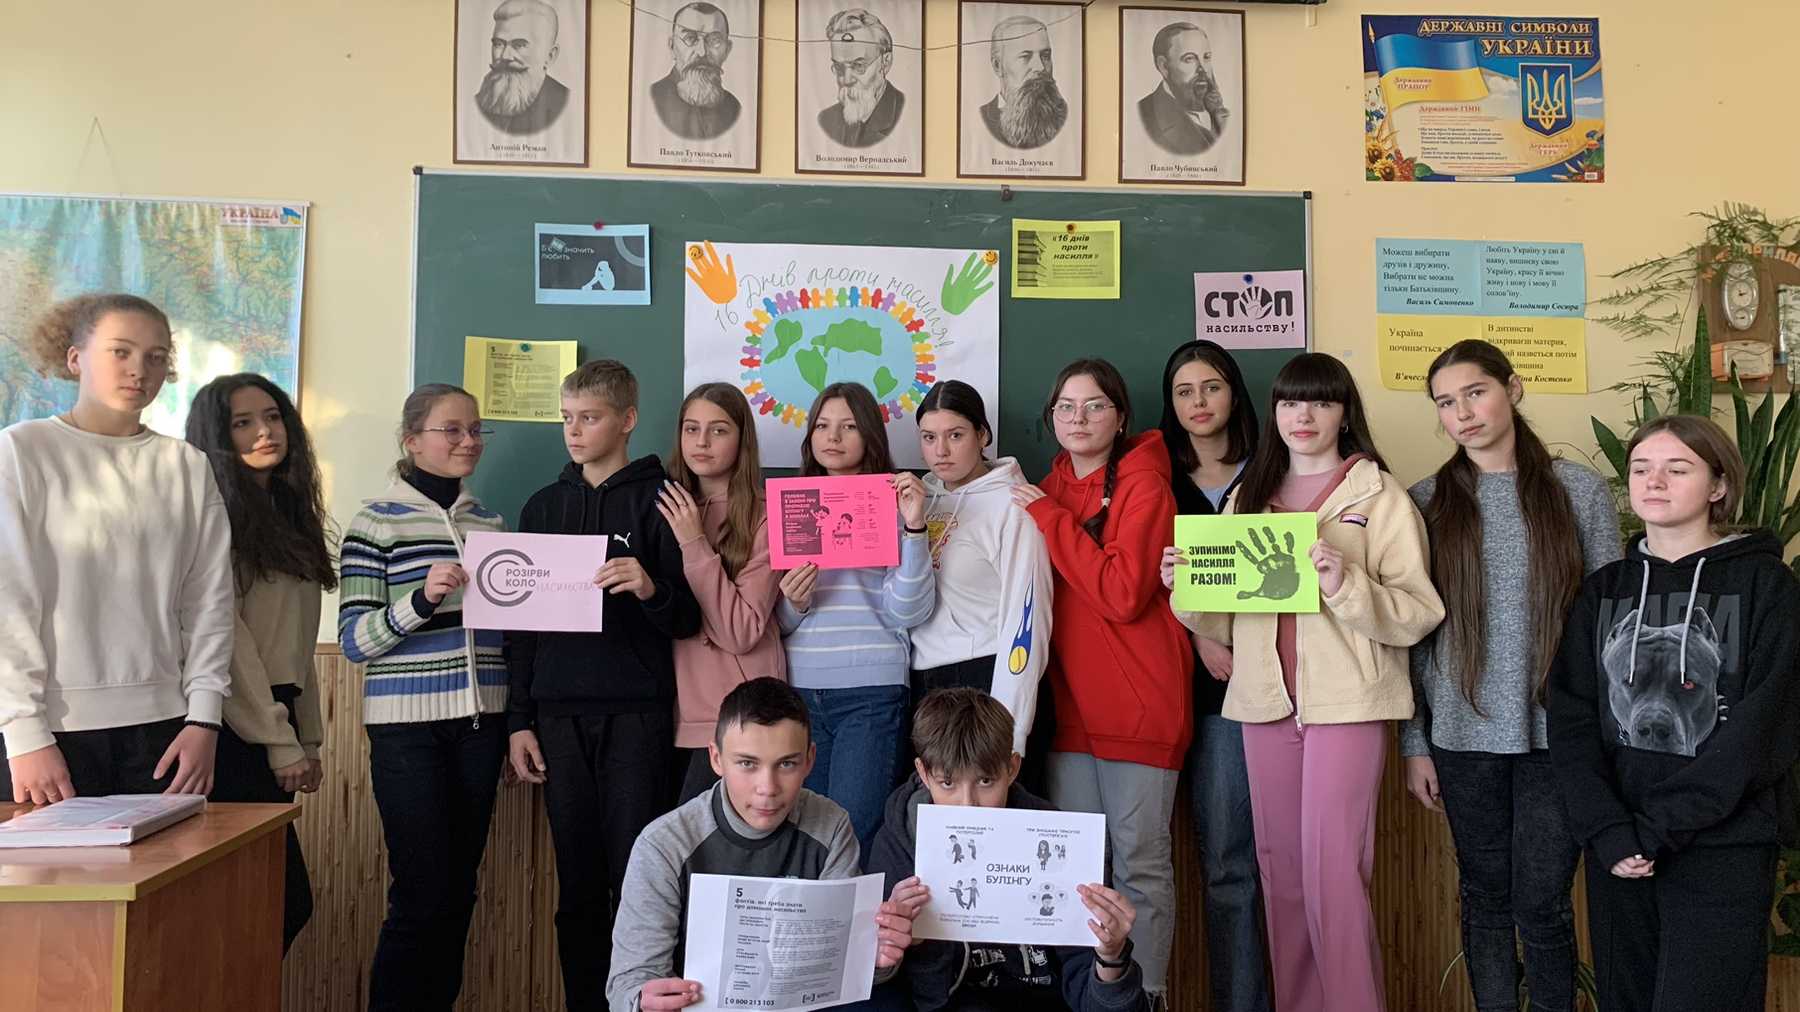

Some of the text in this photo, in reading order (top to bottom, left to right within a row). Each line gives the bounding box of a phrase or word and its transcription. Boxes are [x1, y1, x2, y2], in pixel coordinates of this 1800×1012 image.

[1418, 19, 1592, 36] ДЕРЖАВНІ СИМВОЛИ
[1480, 36, 1593, 56] УКРАЇНИ
[1383, 248, 1450, 258] Можеш вибирати
[1513, 246, 1540, 255] Україну
[1383, 272, 1416, 281] Вибрати
[1204, 286, 1293, 320] СТОП
[1509, 302, 1550, 311] Володимир
[1206, 321, 1295, 334] насильству!
[1487, 324, 1494, 332] В
[1389, 328, 1424, 339] Україна
[1389, 344, 1442, 353] починається
[1555, 351, 1577, 359] потім
[1188, 545, 1237, 556] ЗУПИНІМО
[1191, 558, 1236, 568] НАСИЛЛЯ
[505, 568, 551, 578] РОЗІРВИ
[505, 578, 537, 588] КОЛО
[1190, 573, 1237, 586] РАЗОМ!
[986, 863, 1031, 874] ОЗНАКИ
[985, 875, 1033, 887] БУЛІНГУ
[736, 887, 744, 898] 5
